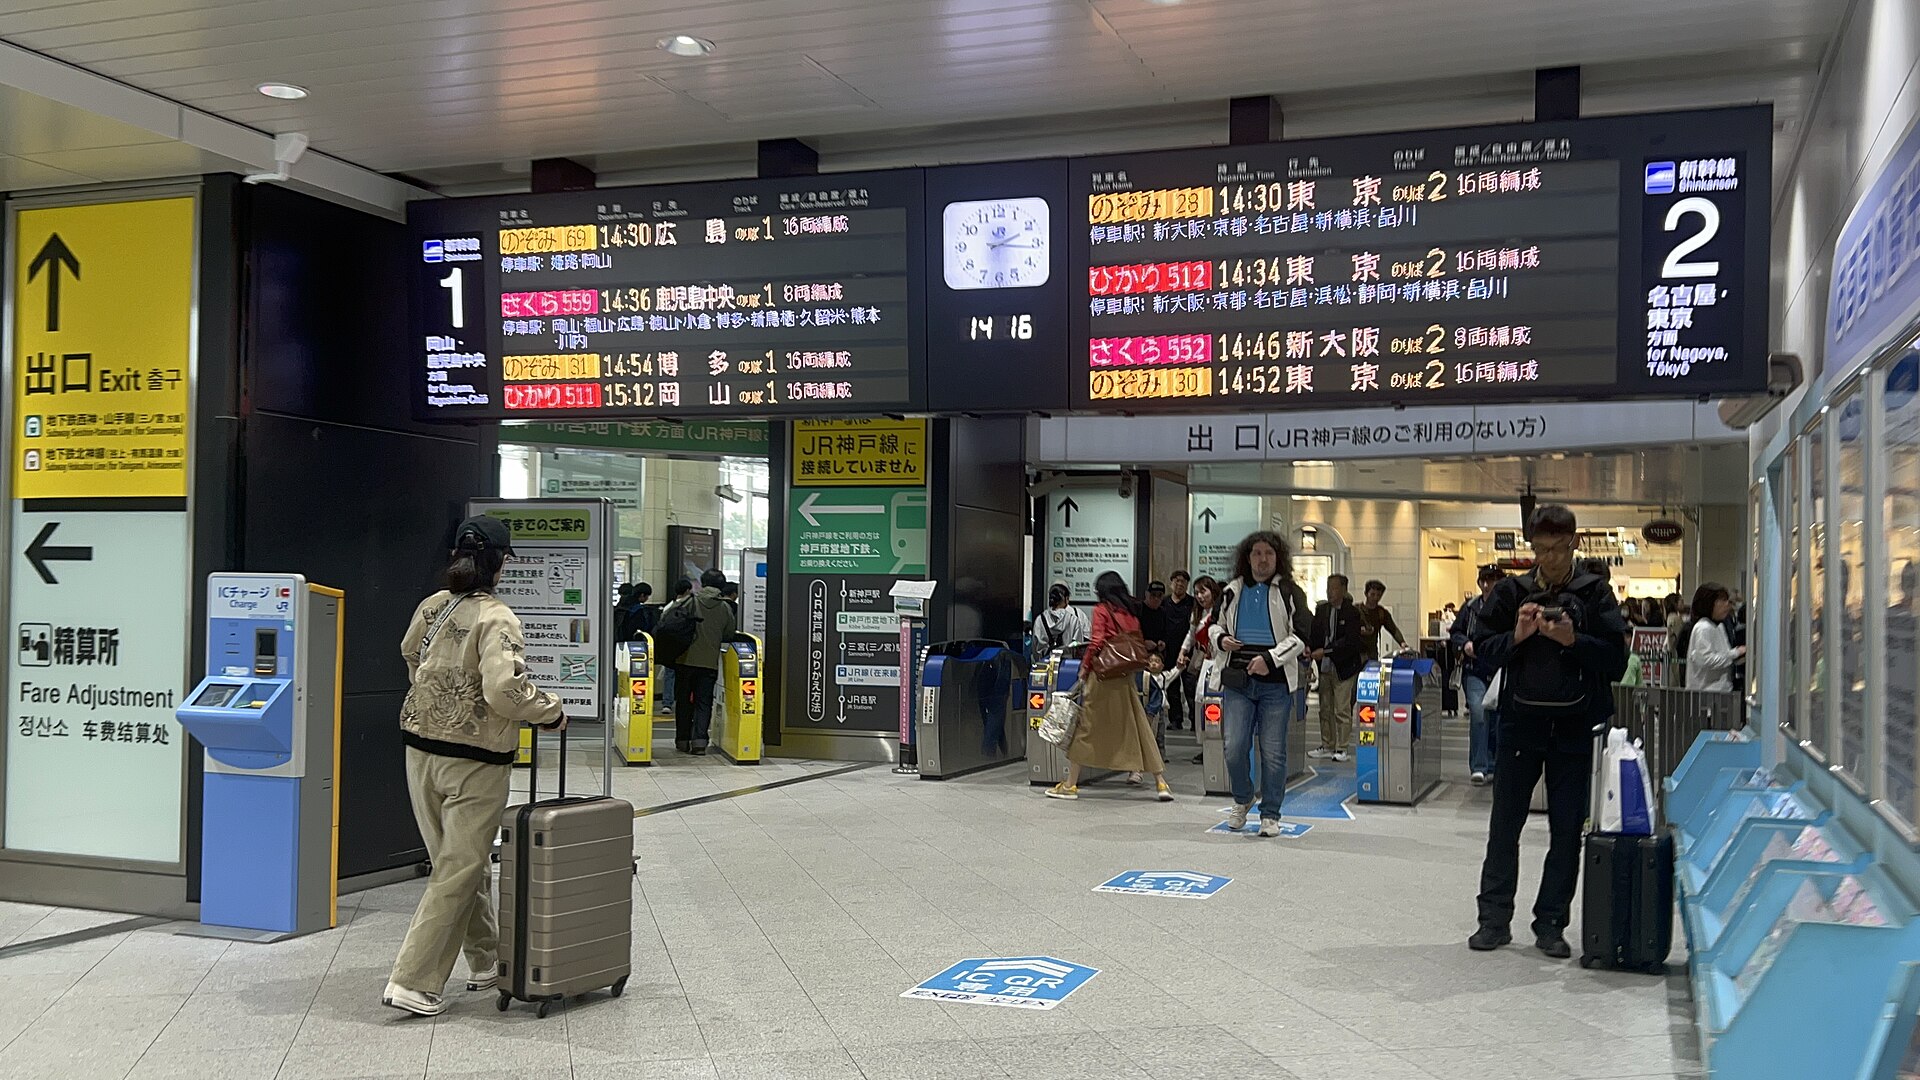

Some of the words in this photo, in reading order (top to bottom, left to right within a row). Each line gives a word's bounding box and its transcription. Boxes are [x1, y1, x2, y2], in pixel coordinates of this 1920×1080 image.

[1393, 147, 1425, 163] のりば
[1288, 165, 1332, 177] Destination
[1394, 159, 1416, 171] Track
[1679, 157, 1736, 179] 新幹線
[1093, 181, 1111, 192] Train
[1112, 179, 1133, 190] Name
[1218, 172, 1255, 183] Departure
[1256, 170, 1275, 180] Time
[1678, 177, 1738, 193] Shinkansen
[1091, 194, 1161, 221] のぞみ
[1175, 192, 1199, 214] 28
[1218, 181, 1282, 215] 14:30
[1286, 175, 1382, 212] 東京
[1392, 182, 1426, 203] のりば
[1426, 169, 1447, 203] 2
[1456, 166, 1542, 196] 16両編成
[978, 213, 989, 224] 11
[992, 207, 1005, 219] 12
[1013, 211, 1018, 221] 1
[502, 230, 557, 252] のぞみ
[566, 229, 586, 247] 69
[601, 222, 649, 248] 14:30
[735, 226, 760, 242] のりば
[763, 215, 774, 241] 1
[782, 214, 850, 236] 16両編成
[965, 224, 979, 236] 10
[1025, 220, 1034, 231] 2
[1090, 223, 1146, 246] 停車駅:
[959, 241, 967, 252] 9
[1031, 237, 1041, 249] 3
[1661, 196, 1720, 279] 2
[501, 256, 545, 273] 停車駅:
[966, 259, 975, 270] 8
[1024, 256, 1034, 268] 4
[1090, 266, 1160, 295] ひかり
[1167, 263, 1205, 289] 512
[1218, 255, 1281, 289] 14:34
[1286, 251, 1381, 287] 東京
[1391, 260, 1425, 279] のりば
[1426, 247, 1447, 279] 2
[1455, 244, 1541, 273] 16両編成
[980, 270, 988, 281] 7
[994, 271, 1004, 283] 6
[440, 267, 464, 328] 1
[502, 293, 559, 317] さくら
[562, 292, 593, 312] 559
[601, 288, 651, 313] 14:36
[656, 284, 736, 312] 鹿児島中央
[736, 293, 761, 308] のりば
[763, 282, 775, 308] 1
[784, 282, 844, 303] 8両編成
[1090, 296, 1145, 317] 停車駅:
[503, 318, 546, 336] 停車駅:
[970, 315, 993, 341] 14
[1010, 314, 1033, 340] 16
[1647, 307, 1693, 330] 東京
[1091, 337, 1160, 365] さくら
[1167, 335, 1205, 361] 552
[1218, 330, 1280, 362] 14:46
[1286, 326, 1381, 360] 新大阪
[1391, 336, 1423, 354] のりば
[1425, 323, 1446, 354] 2
[1647, 330, 1679, 346] 方面
[1647, 346, 1667, 362] for
[1670, 344, 1729, 364] Nagoya,
[504, 359, 560, 379] のぞみ
[570, 357, 587, 376] 31
[603, 352, 653, 378] 14:54
[657, 350, 730, 377] 博多
[738, 360, 763, 375] のりば
[766, 349, 778, 375] 1
[786, 350, 852, 371] 16両編成
[25, 352, 92, 396] 出口
[100, 367, 142, 393] Exit
[147, 368, 183, 391] 출구
[1091, 373, 1161, 396] のぞみ
[1175, 371, 1198, 392] 30
[1218, 365, 1281, 396] 14:52
[1286, 360, 1380, 394] 東京
[1390, 371, 1423, 390] のりば
[1425, 358, 1446, 390] 2
[1454, 358, 1540, 384] 16両編成
[504, 385, 560, 408] ひかり
[565, 384, 595, 405] 511
[604, 382, 654, 407] 15:12
[659, 381, 731, 407] 岡山
[739, 390, 764, 405] のりば
[766, 380, 779, 405] 1
[787, 380, 853, 400] 16両編成
[656, 424, 685, 440] 方面
[1187, 423, 1261, 453] 出口
[1267, 415, 1547, 450] (JR神戸線のご利用のない方)
[802, 433, 916, 456] JR神戸線に
[801, 459, 917, 475] 接続していません
[799, 543, 880, 555] 神戸市営地下鉄へ
[218, 586, 271, 599] ICチャージ
[849, 589, 880, 599] 新神戸駅
[229, 600, 258, 610] Charge
[811, 587, 824, 642] JR神戸線
[54, 627, 120, 667] 精算所
[810, 649, 823, 713] のりかえ方法
[20, 681, 60, 704] Fare
[67, 682, 174, 712] Adjustment
[847, 695, 877, 705] JR各駅
[19, 715, 70, 738] 정산소
[83, 719, 170, 746] 车费结算处
[1124, 876, 1157, 885] IC
[951, 970, 995, 982] IC
[1003, 975, 1065, 989] QR
[953, 981, 1038, 997] 専用
